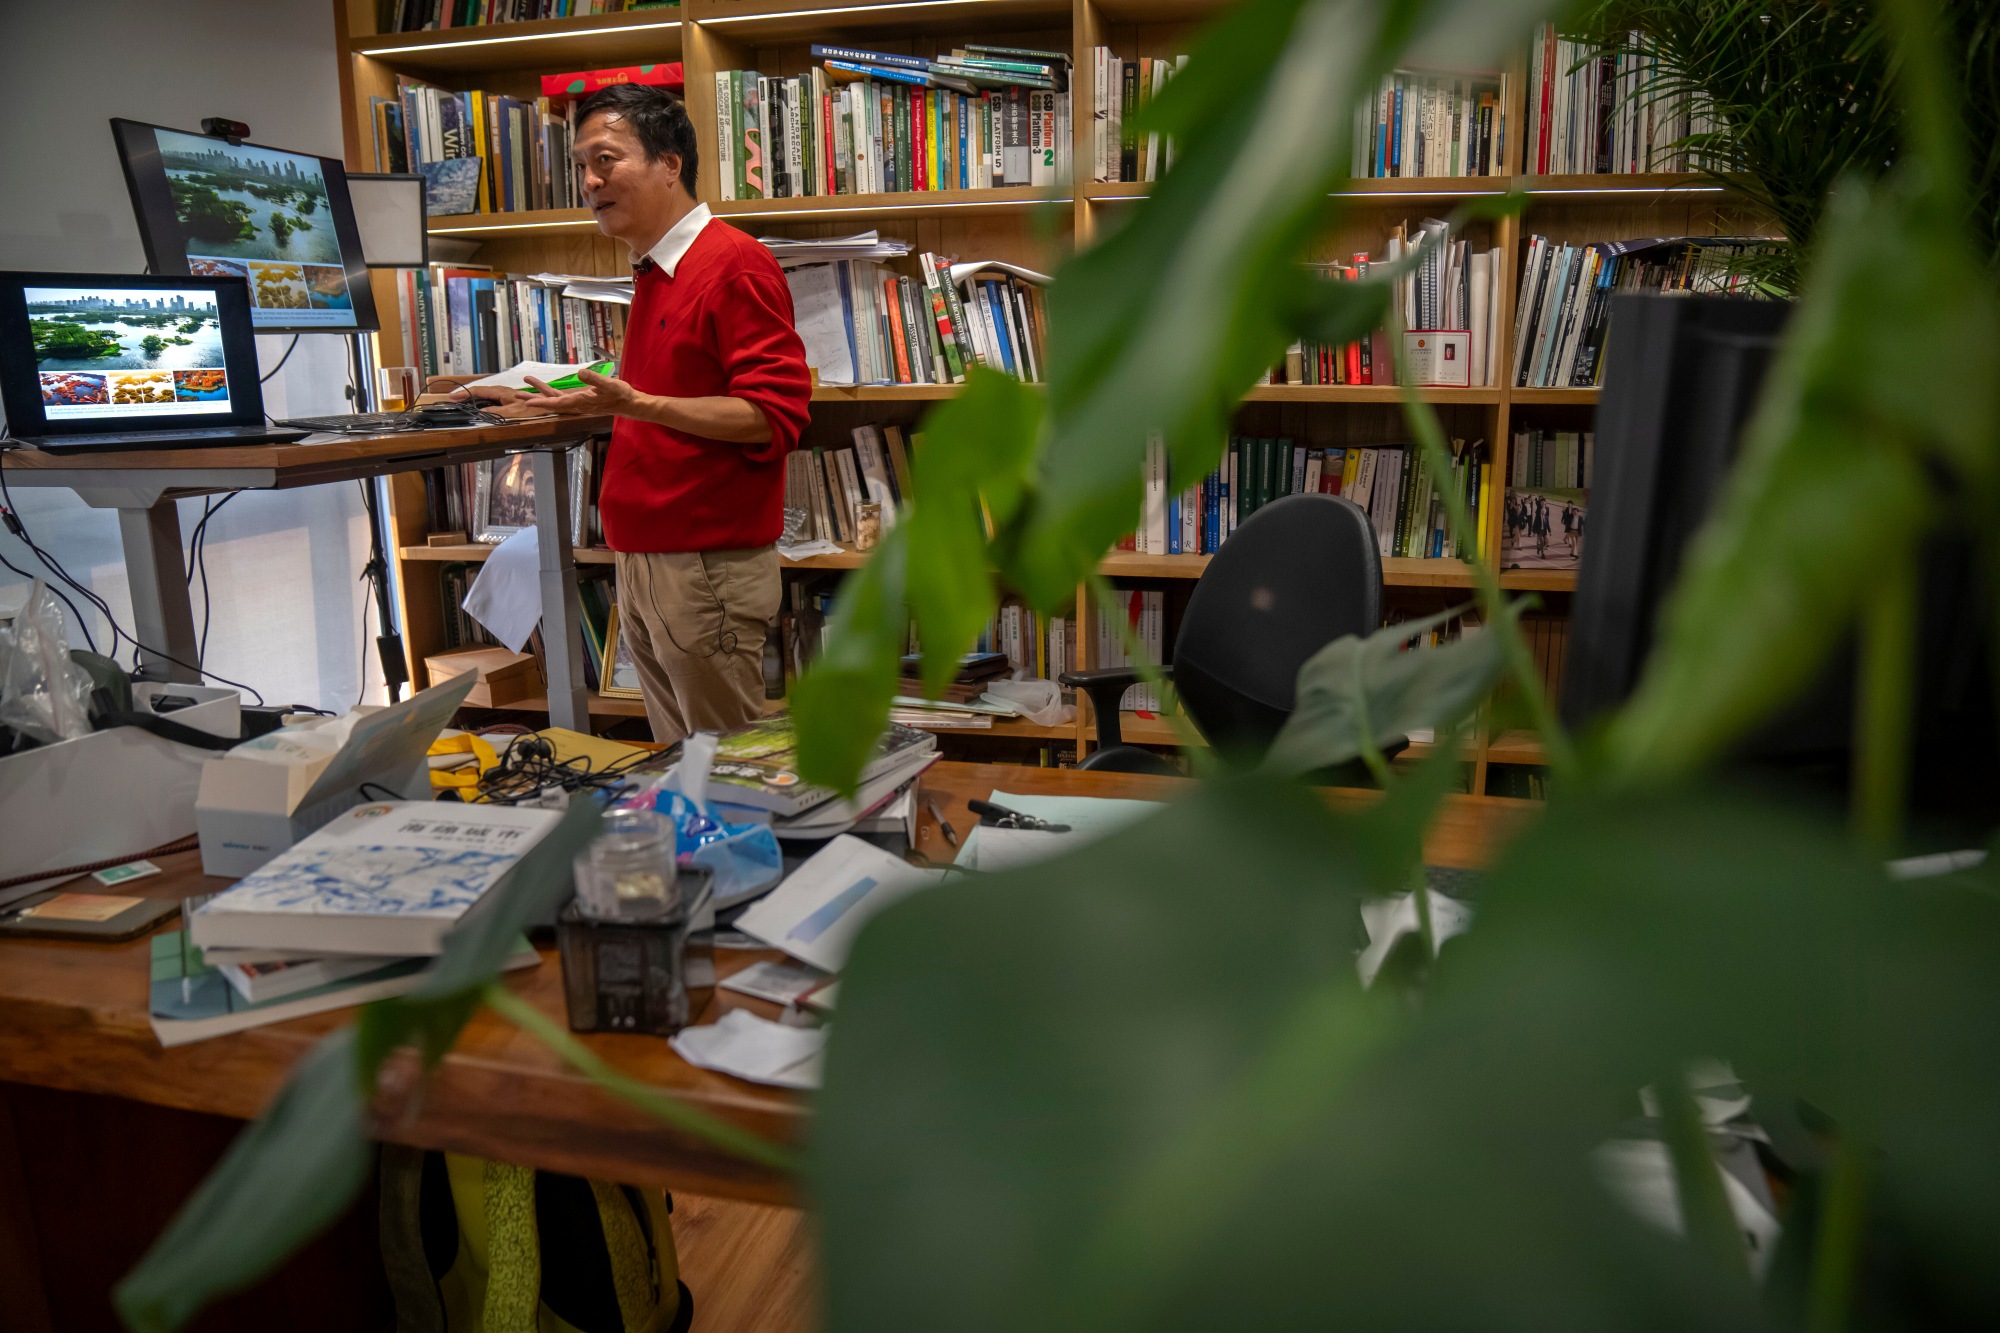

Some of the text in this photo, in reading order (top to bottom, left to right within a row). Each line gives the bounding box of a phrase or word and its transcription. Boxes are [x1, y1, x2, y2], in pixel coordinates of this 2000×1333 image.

[716, 79, 726, 162] LANDSCAPE ARCHITECTURE
[724, 118, 730, 126] OF
[1044, 112, 1054, 147] Platform
[888, 143, 893, 151] OF
[1044, 149, 1054, 166] 2
[996, 159, 1001, 168] 5
[943, 270, 966, 345] LANDSCAPE ARCHITECTURE
[418, 288, 430, 374] SLOVENSKE KRAJINE
[908, 323, 918, 347] PASSAGES
[1186, 498, 1194, 526] century
